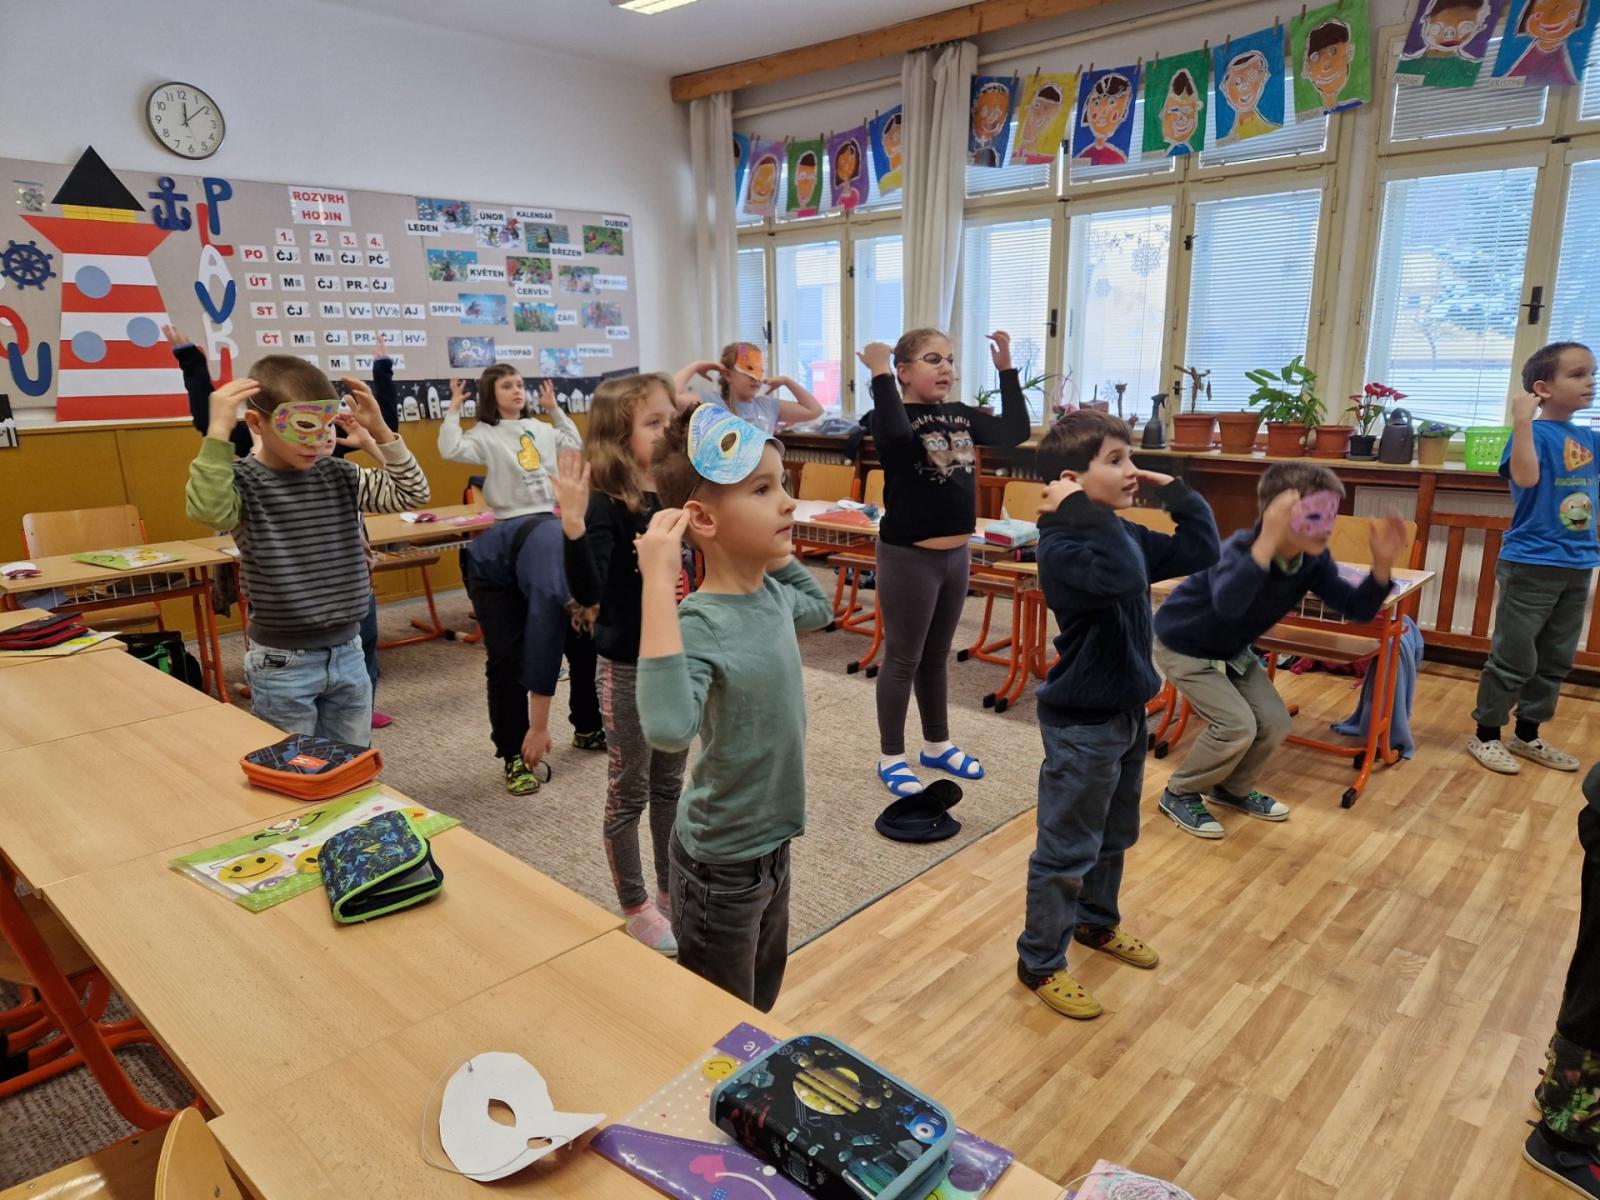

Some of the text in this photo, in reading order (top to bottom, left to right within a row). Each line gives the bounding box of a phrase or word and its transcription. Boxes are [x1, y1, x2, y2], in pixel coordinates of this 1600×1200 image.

[166, 92, 174, 103] 11
[177, 90, 187, 101] 12
[194, 95, 199, 105] 1
[157, 101, 167, 111] 10
[205, 105, 211, 115] 2
[155, 115, 162, 125] 9
[210, 120, 217, 130] 3
[162, 128, 170, 138] 8
[208, 133, 215, 141] 4
[173, 139, 181, 149] 7
[188, 144, 195, 154] 6
[201, 141, 208, 152] 5
[292, 191, 345, 204] ROZVRH
[407, 223, 438, 233] LEDEN
[604, 219, 628, 228] DUBEN
[280, 232, 381, 247] 1. 2. 3. 4.
[244, 250, 263, 259] PO
[276, 250, 293, 261] ČJ
[340, 253, 356, 264] ČJ
[369, 253, 384, 264] PČ
[470, 267, 504, 277] KVĚTEN
[249, 276, 267, 287] ÚT
[317, 279, 333, 290] ČJ
[347, 280, 362, 290] PR
[372, 279, 387, 290] ČJ
[516, 286, 549, 297] ČERVEN
[256, 306, 273, 315] ST
[286, 305, 303, 316] ČJ
[404, 306, 418, 315] AJ
[431, 305, 462, 314] SRPEN
[262, 333, 279, 343] ČT
[325, 333, 341, 343] ČJ
